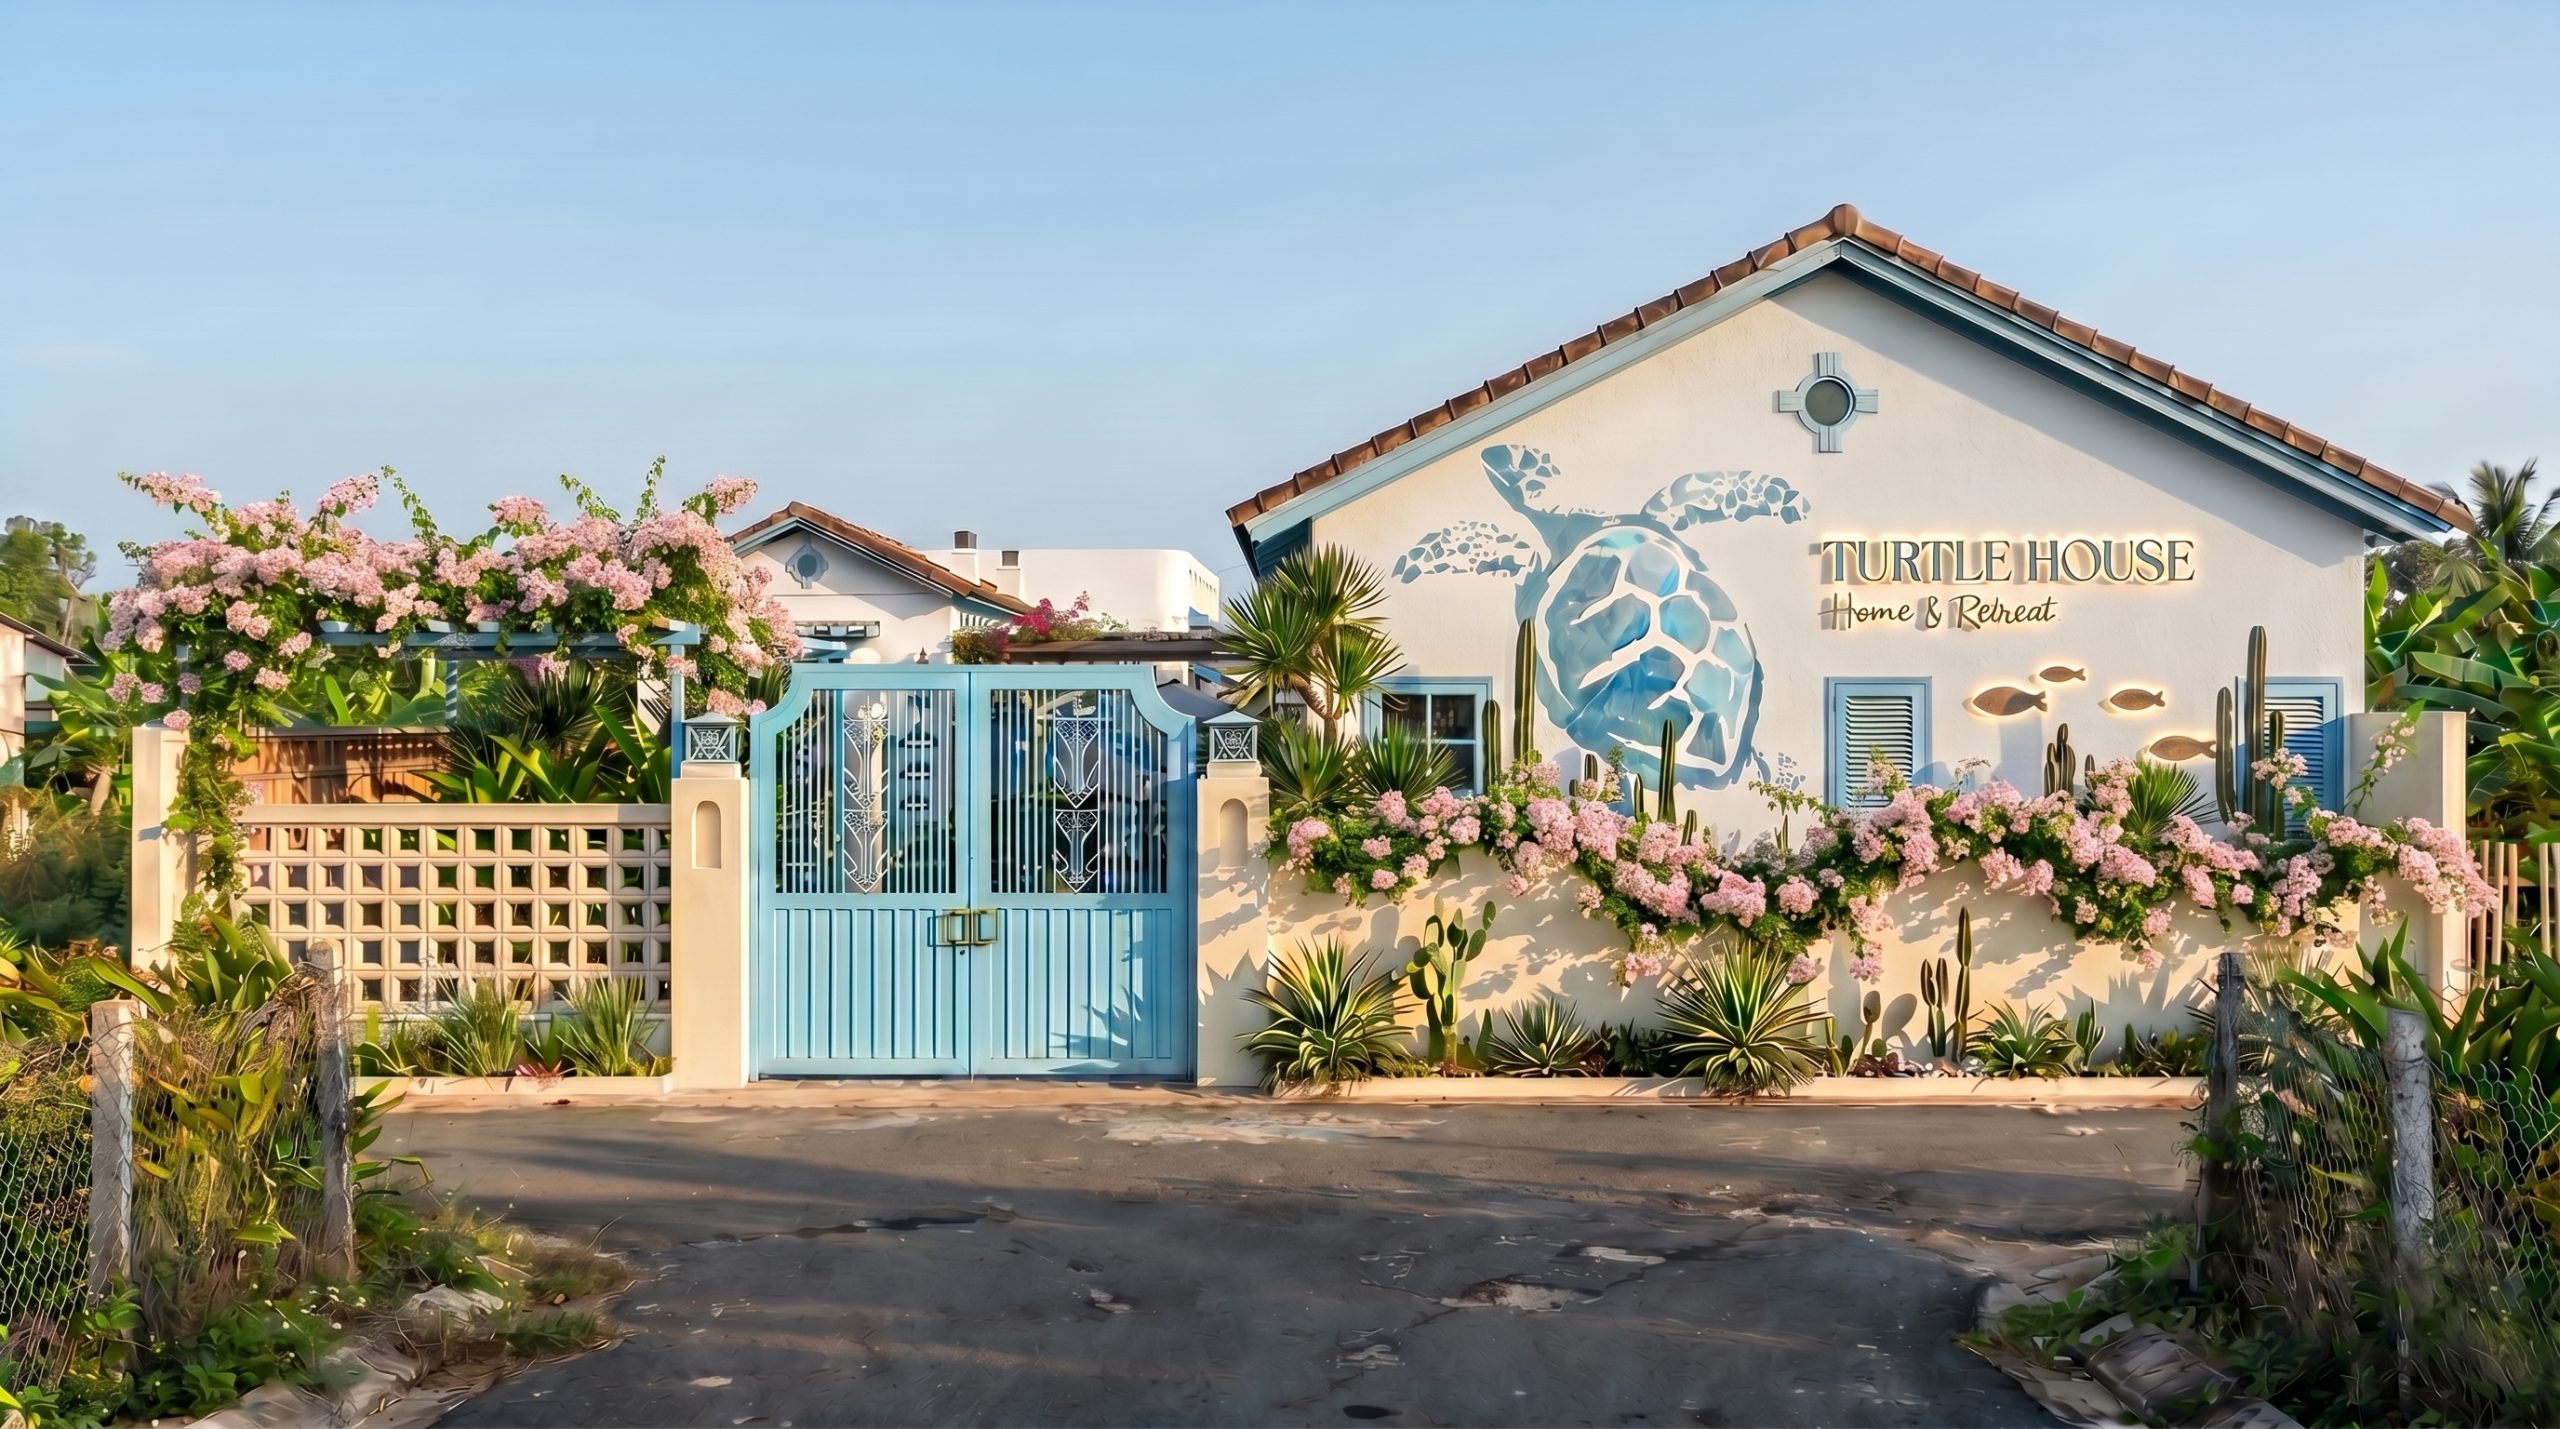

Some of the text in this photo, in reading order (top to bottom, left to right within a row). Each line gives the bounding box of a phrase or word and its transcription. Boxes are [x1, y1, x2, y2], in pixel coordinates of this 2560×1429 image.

[1823, 539, 2196, 582] TURTLE HOUSE
[1818, 592, 2059, 630] Home & Retreat
